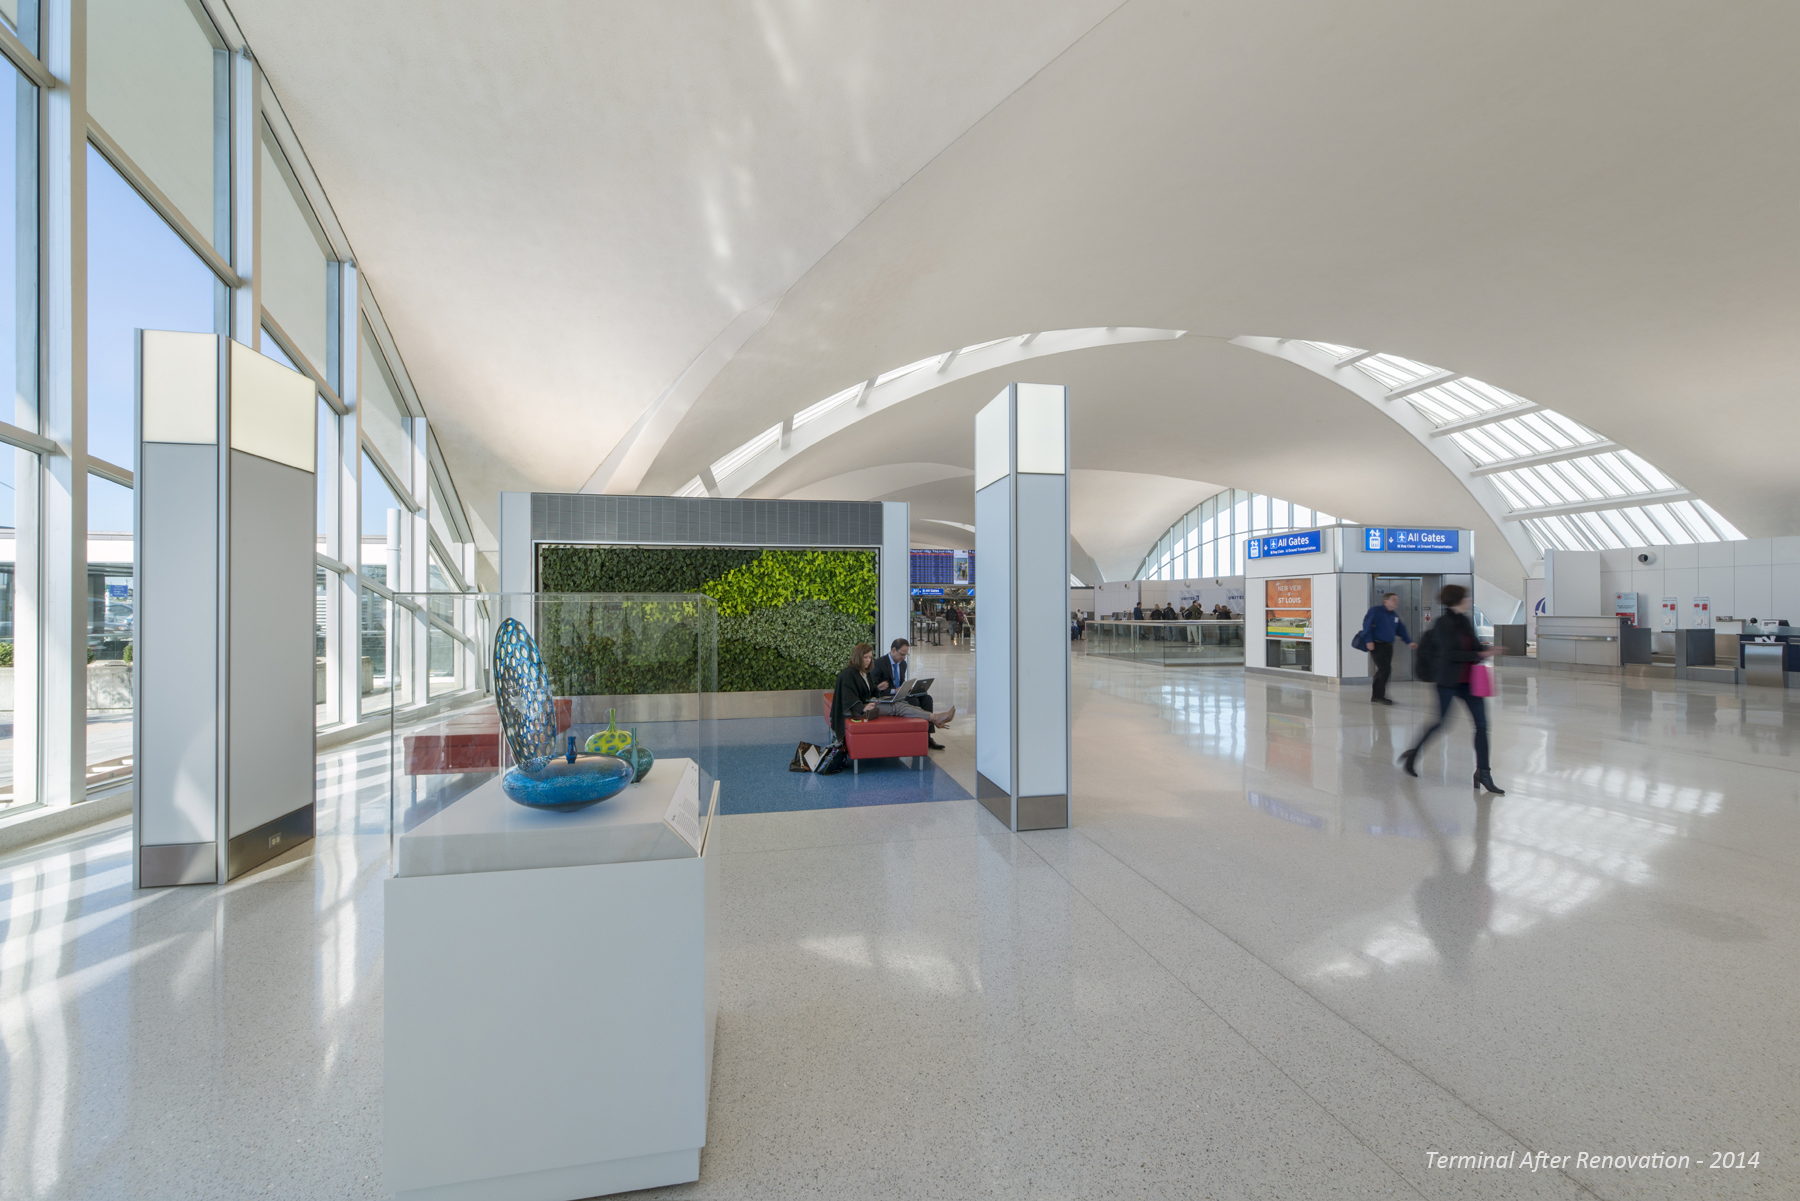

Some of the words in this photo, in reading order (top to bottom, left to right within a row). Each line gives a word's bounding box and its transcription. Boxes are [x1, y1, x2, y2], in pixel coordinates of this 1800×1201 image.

[1278, 538, 1287, 547] All
[1288, 536, 1309, 546] Gates
[1407, 533, 1419, 542] All
[1421, 533, 1446, 542] Gates
